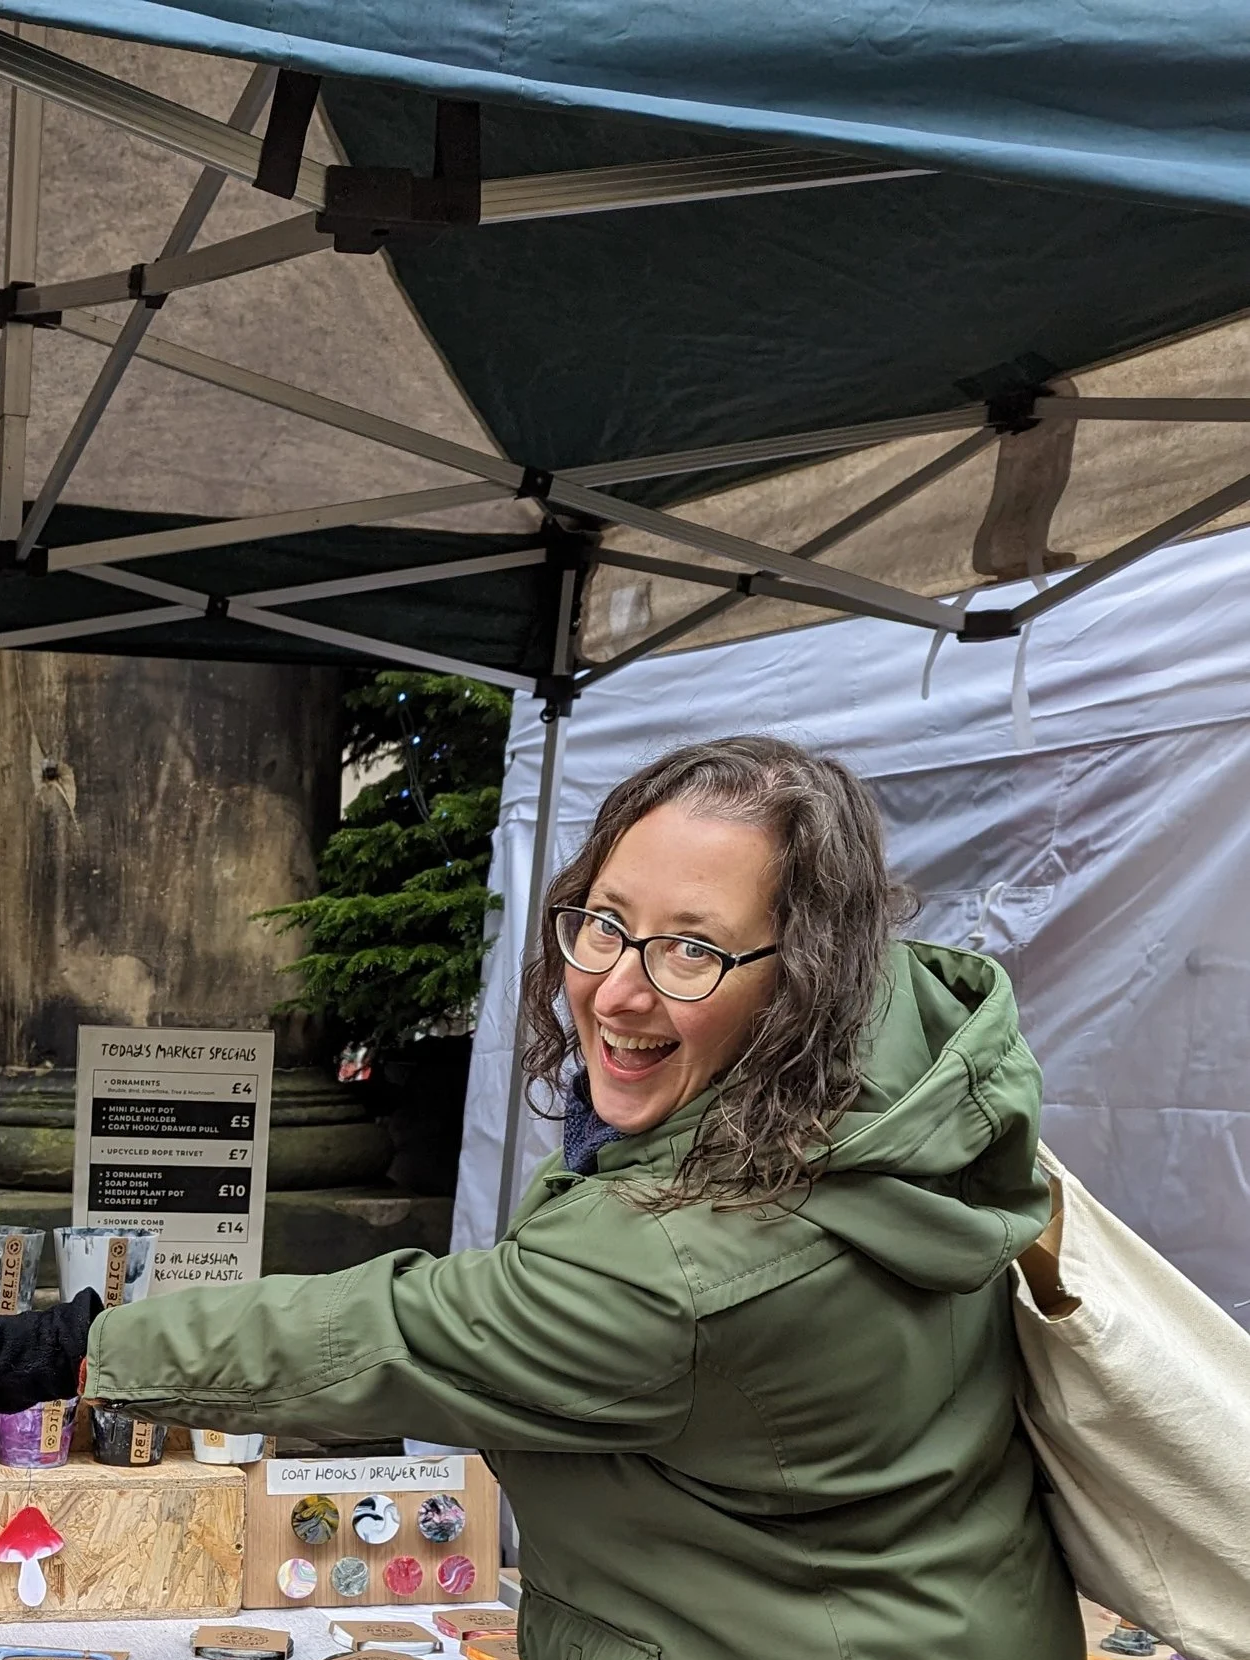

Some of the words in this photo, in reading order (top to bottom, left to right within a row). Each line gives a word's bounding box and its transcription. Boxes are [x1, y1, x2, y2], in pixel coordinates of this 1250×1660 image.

[102, 1043, 151, 1057] TODAY'S
[155, 1044, 205, 1059] MARKET
[232, 1082, 252, 1094] £4
[130, 1106, 156, 1114] PLANT
[230, 1115, 250, 1128] £5
[132, 1124, 160, 1132] HOOK/
[161, 1125, 197, 1133] DRAWER
[199, 1126, 219, 1134] PULL
[107, 1148, 150, 1156] UPCYCLED
[228, 1148, 248, 1160] £7
[112, 1171, 162, 1179] ORNAMENTS
[130, 1180, 149, 1188] DISH
[218, 1184, 246, 1197] £10
[143, 1198, 158, 1206] SET
[103, 1218, 138, 1226] SHOWER
[216, 1222, 244, 1234] £14
[186, 1252, 238, 1266] HEYSHAM
[154, 1268, 202, 1282] RECYCLED
[204, 1269, 244, 1281] PLASTIC
[1, 1258, 16, 1310] RELIC
[50, 1400, 62, 1432] ELIC
[134, 1420, 148, 1459] RELI
[282, 1468, 311, 1481] COAT
[316, 1467, 358, 1482] HOOKS
[369, 1465, 416, 1482] DRAWER
[420, 1465, 450, 1478] PULLS
